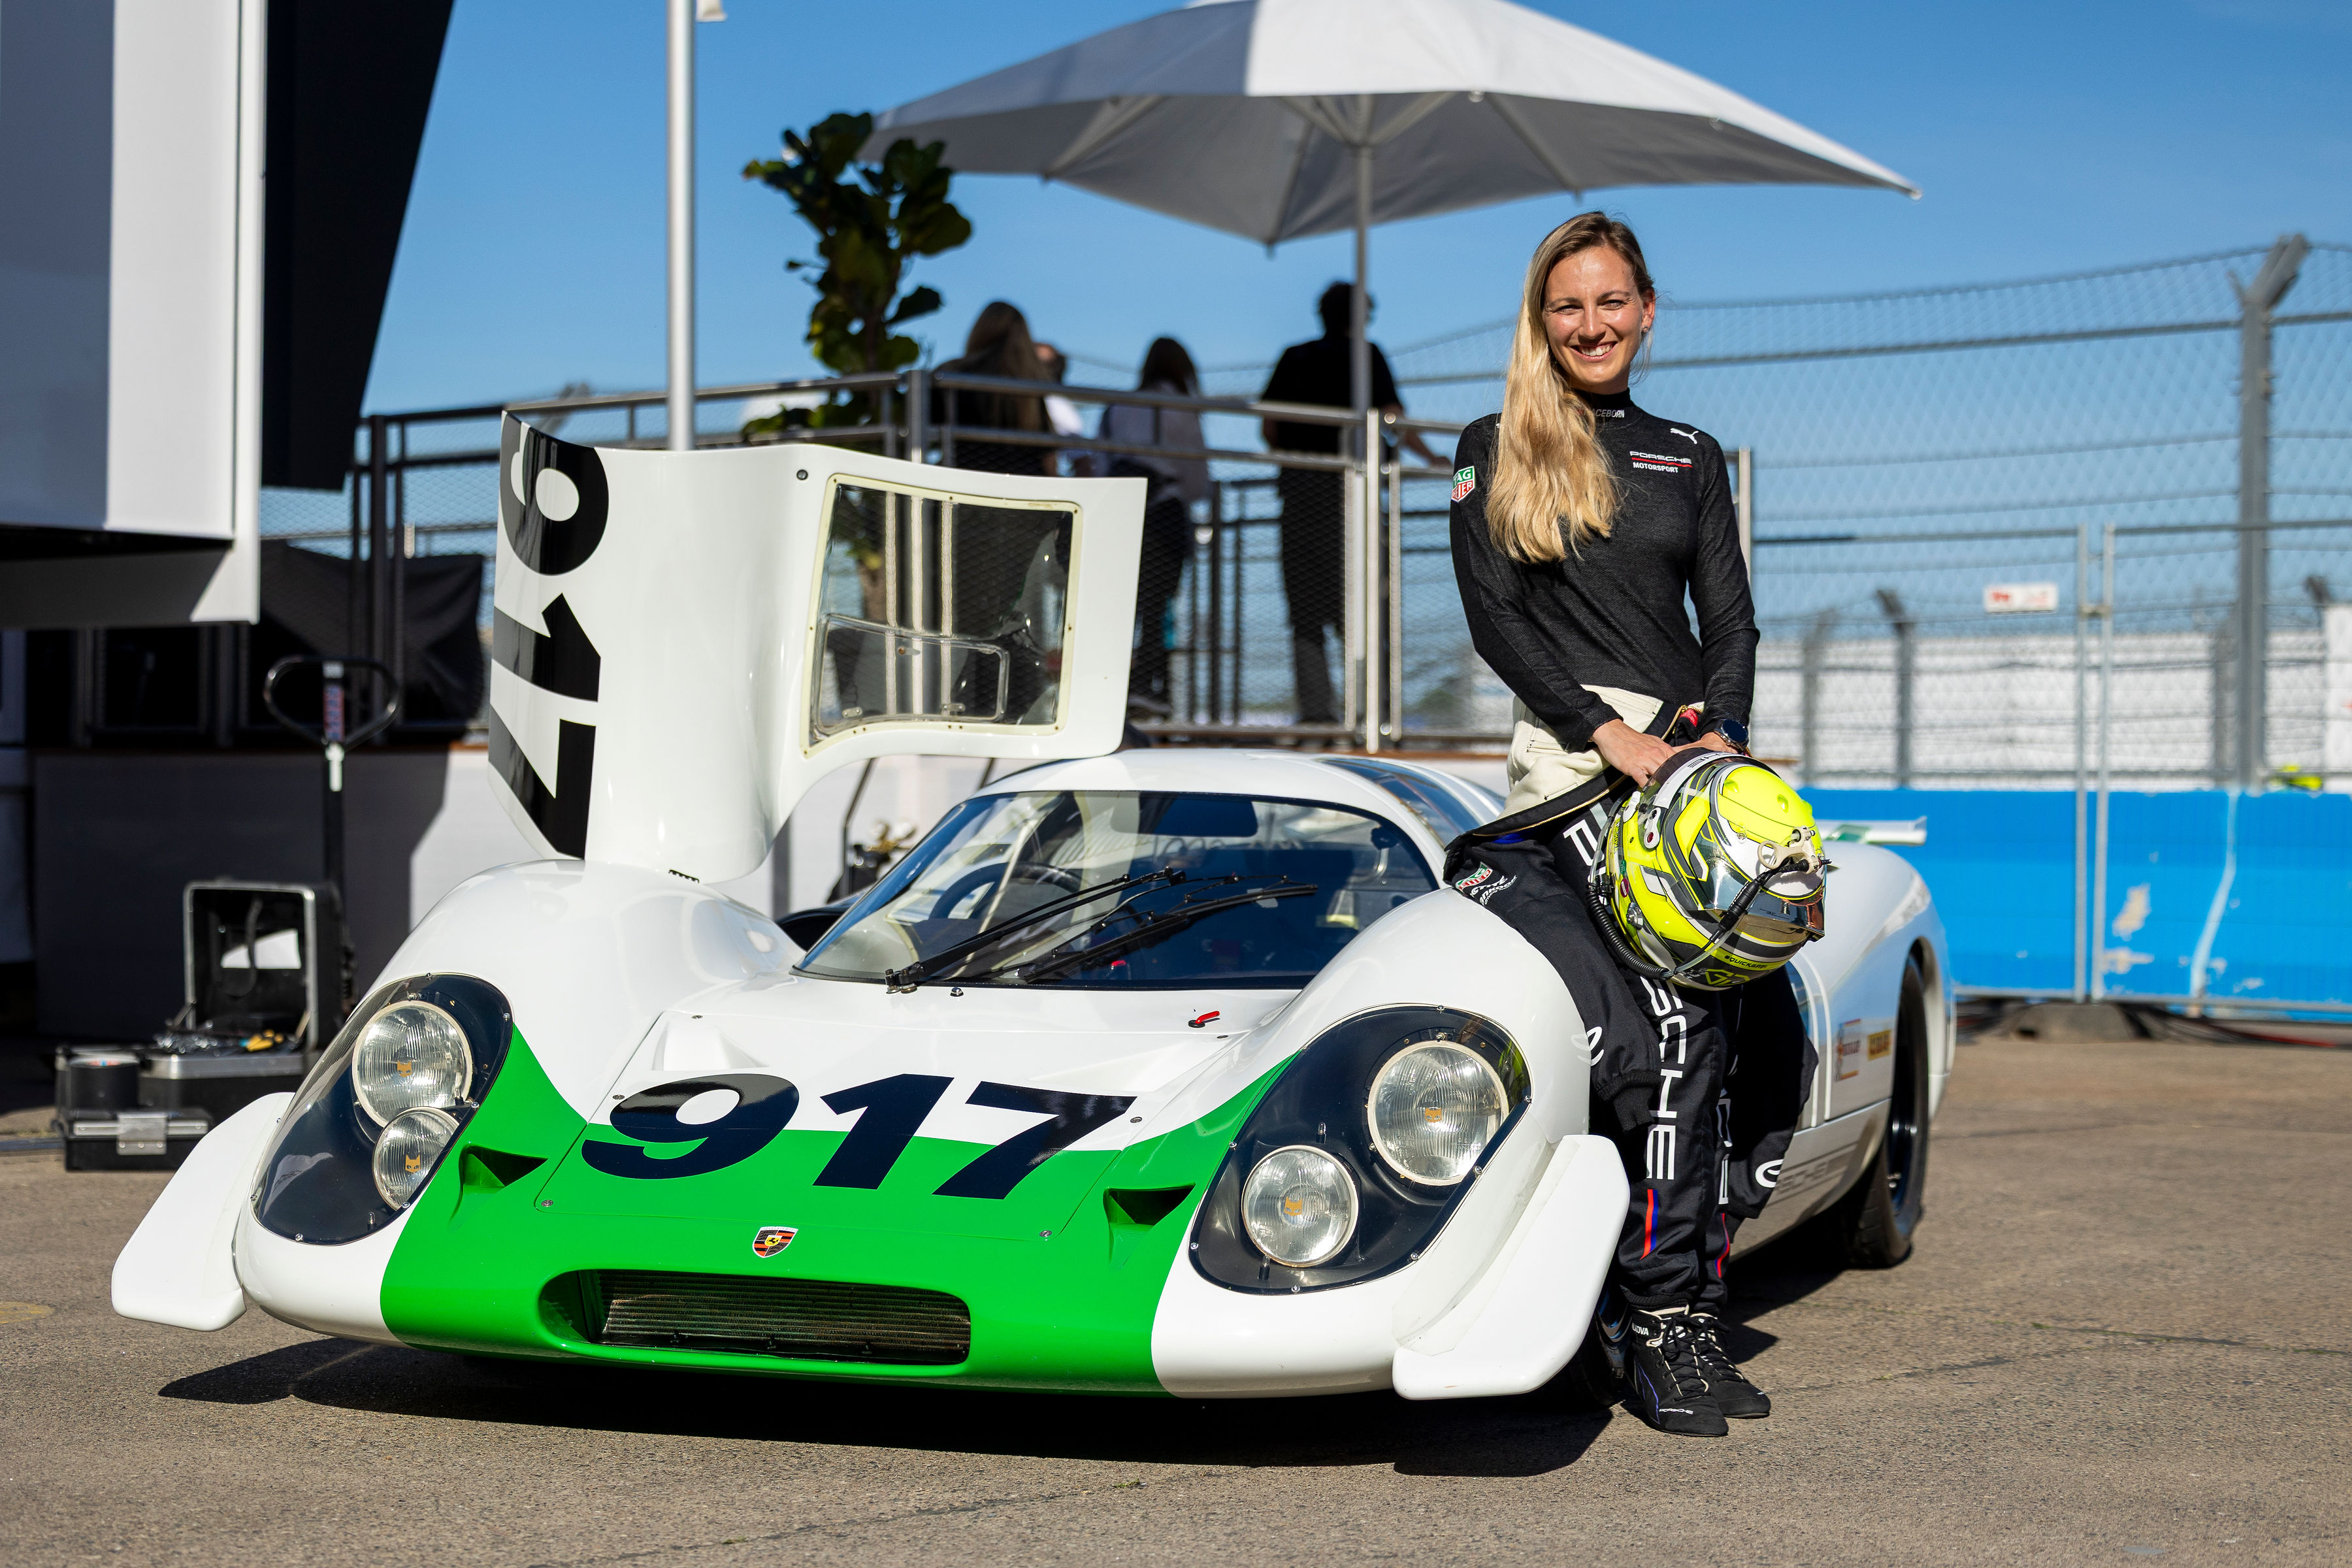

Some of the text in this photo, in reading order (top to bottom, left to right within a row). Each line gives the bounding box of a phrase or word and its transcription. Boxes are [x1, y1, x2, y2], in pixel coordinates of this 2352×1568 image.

[1629, 451, 1692, 465] PORSCHE
[1633, 462, 1678, 473] MOTORSPORT
[1453, 469, 1472, 487] TAG
[488, 412, 609, 860] 917
[581, 1072, 1137, 1200] 917
